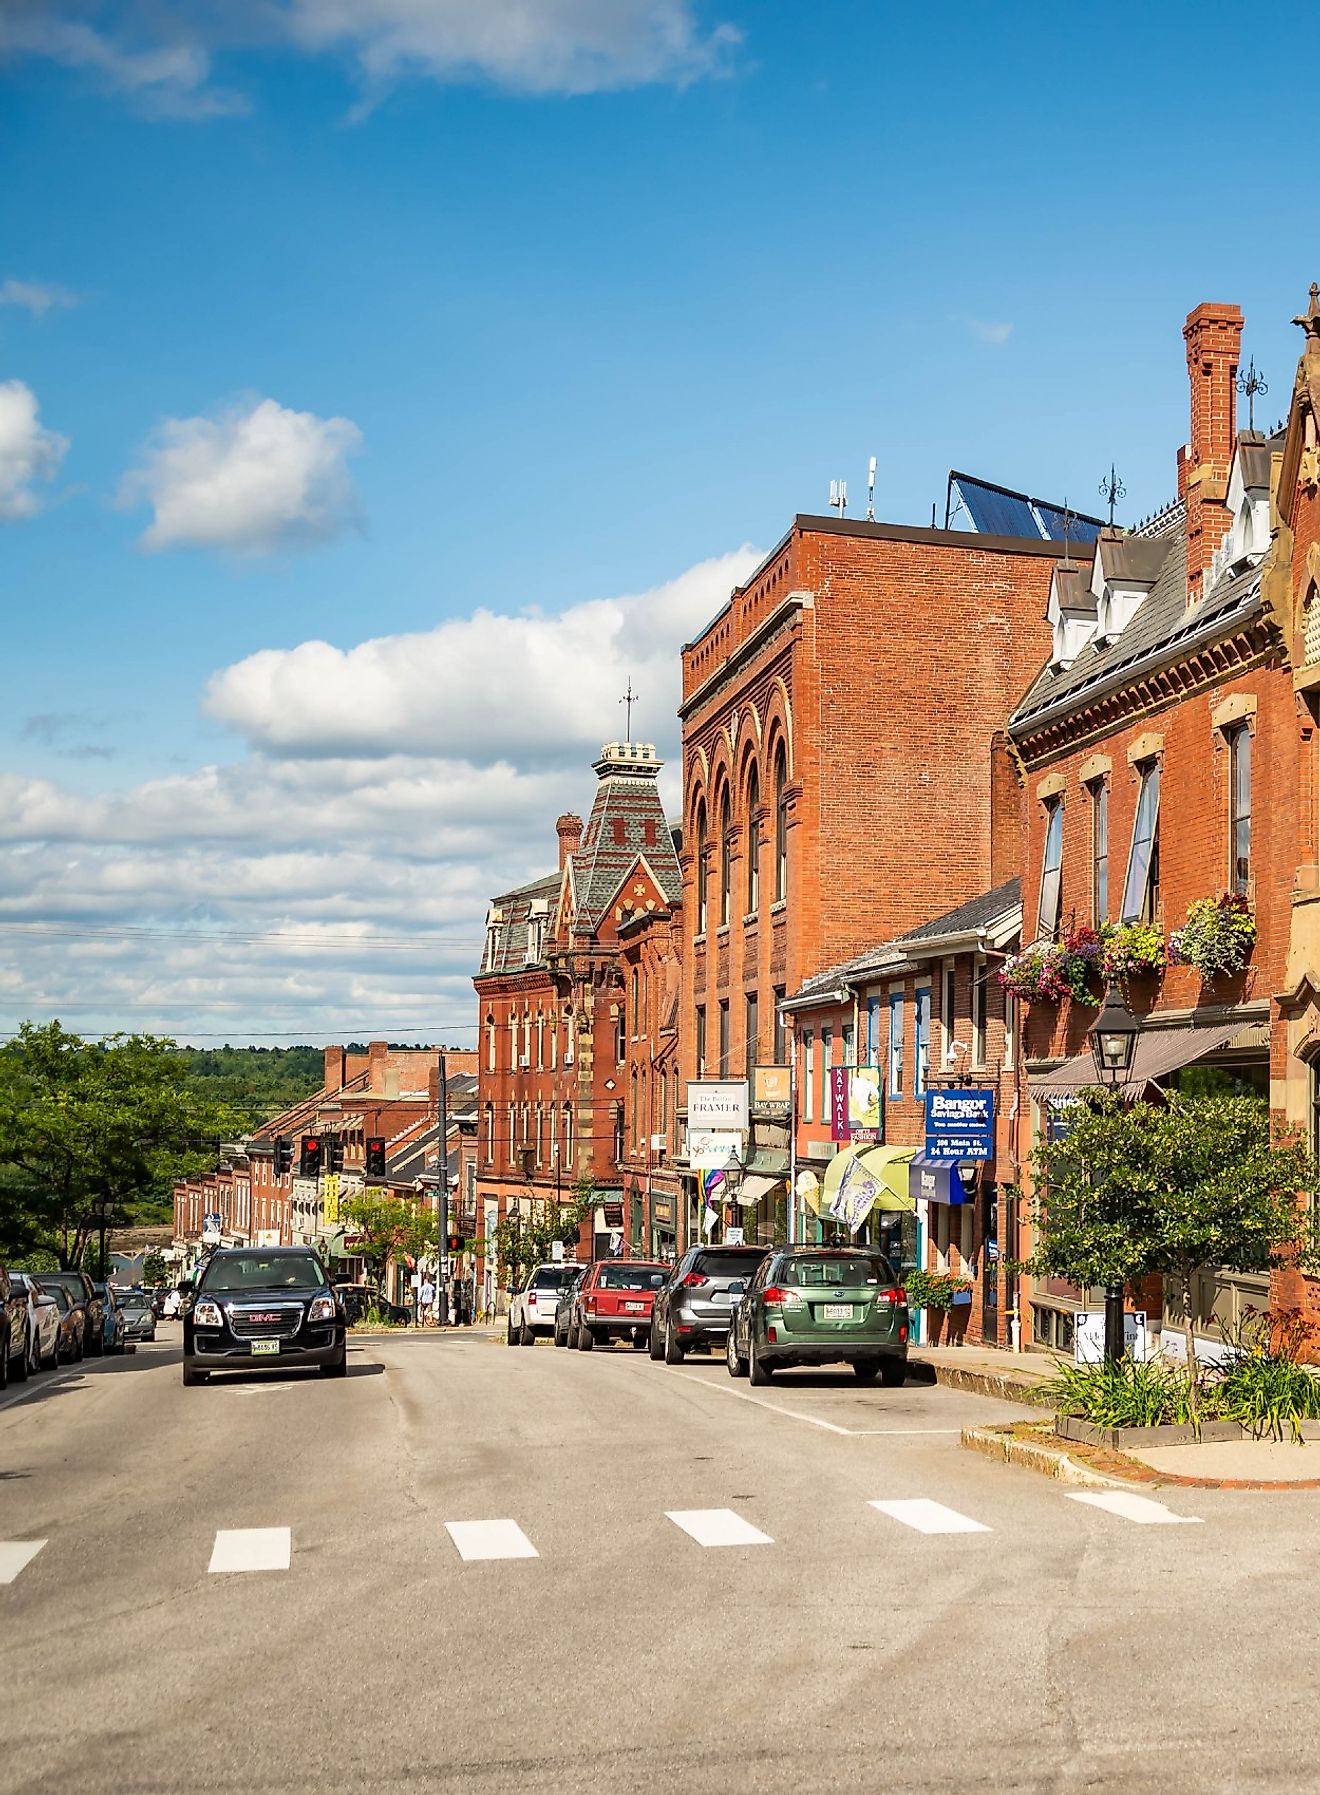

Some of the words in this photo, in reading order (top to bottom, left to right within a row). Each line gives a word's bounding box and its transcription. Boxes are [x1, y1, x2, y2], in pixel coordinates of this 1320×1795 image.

[834, 1068, 844, 1130] KATWALK
[933, 1095, 987, 1111] Bangor
[693, 1103, 740, 1112] FRAMER
[755, 1101, 769, 1109] BAY
[769, 1101, 790, 1109] WRAP
[930, 1109, 965, 1119] Savings
[966, 1109, 989, 1118] Bank
[950, 1139, 970, 1147] Main
[972, 1139, 982, 1147] St.
[930, 1147, 940, 1156] 24
[942, 1147, 964, 1156] Hour
[966, 1147, 988, 1156] ATM
[250, 1313, 282, 1322] GMC
